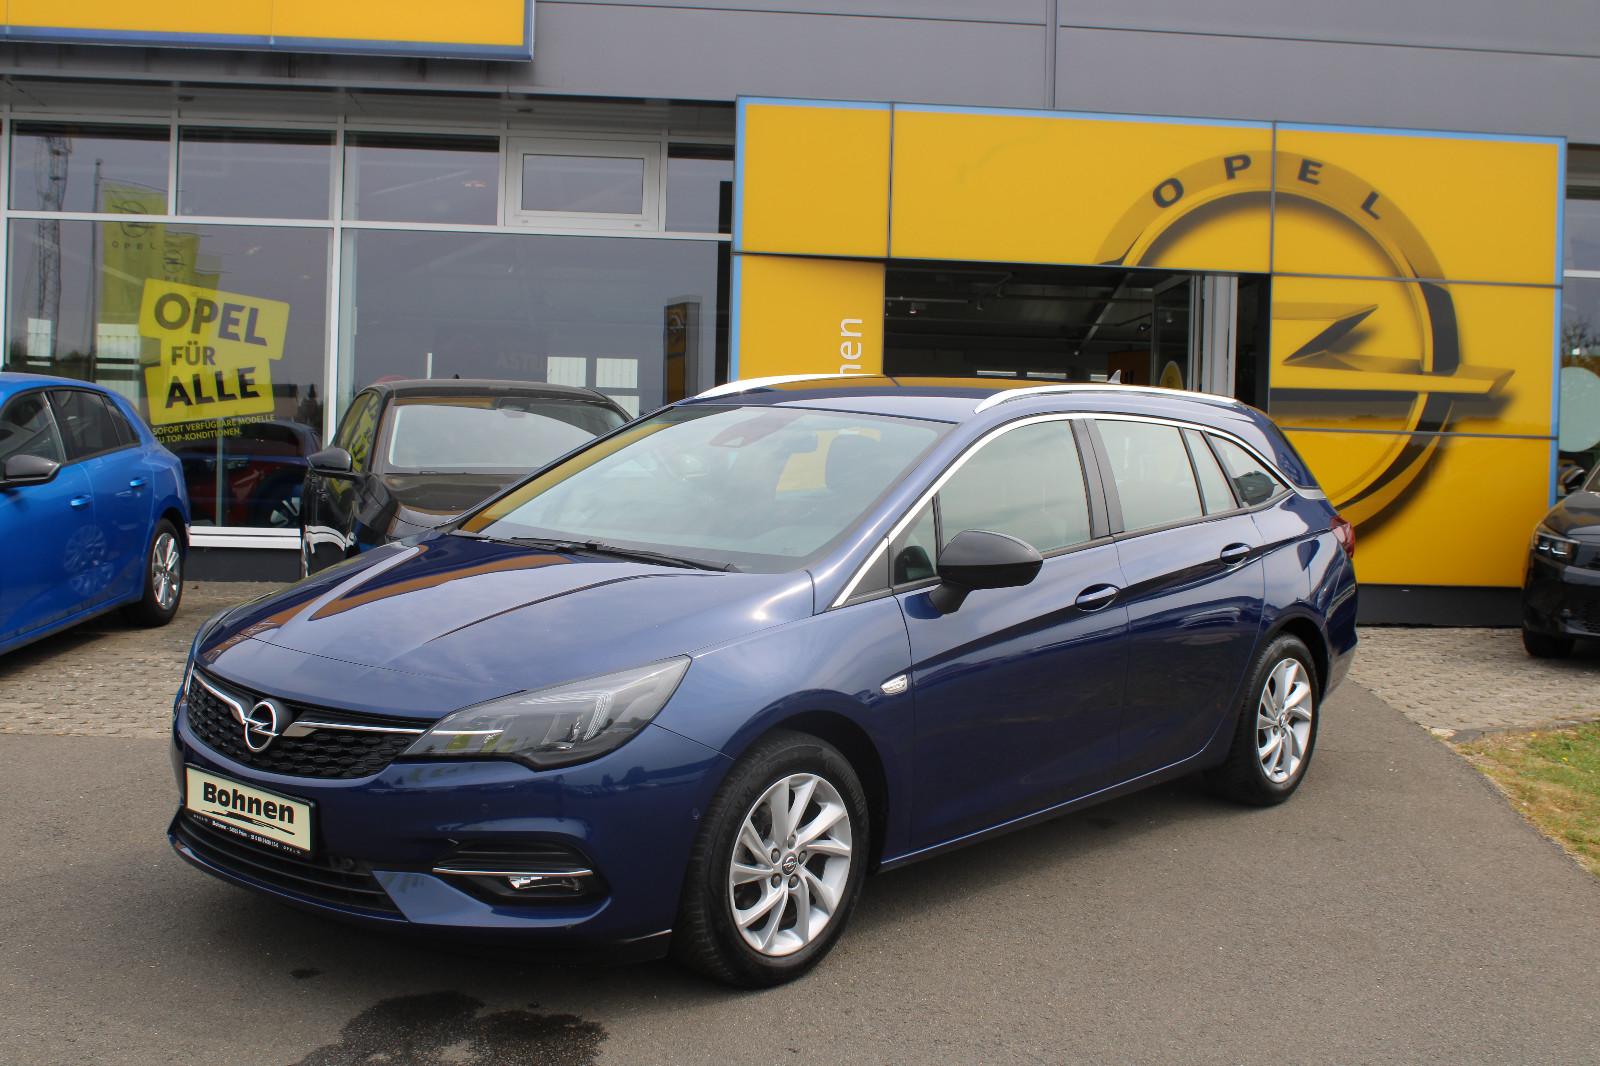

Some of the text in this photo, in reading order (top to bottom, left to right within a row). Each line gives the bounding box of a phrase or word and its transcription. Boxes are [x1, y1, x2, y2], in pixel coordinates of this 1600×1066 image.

[1152, 154, 1381, 220] OPEL
[154, 293, 267, 346] OPEL
[171, 341, 216, 366] FÜR
[165, 367, 260, 409] ALLE
[152, 424, 184, 436] SOFORT
[238, 415, 276, 425] MODELLE
[203, 782, 295, 824] Bohnen
